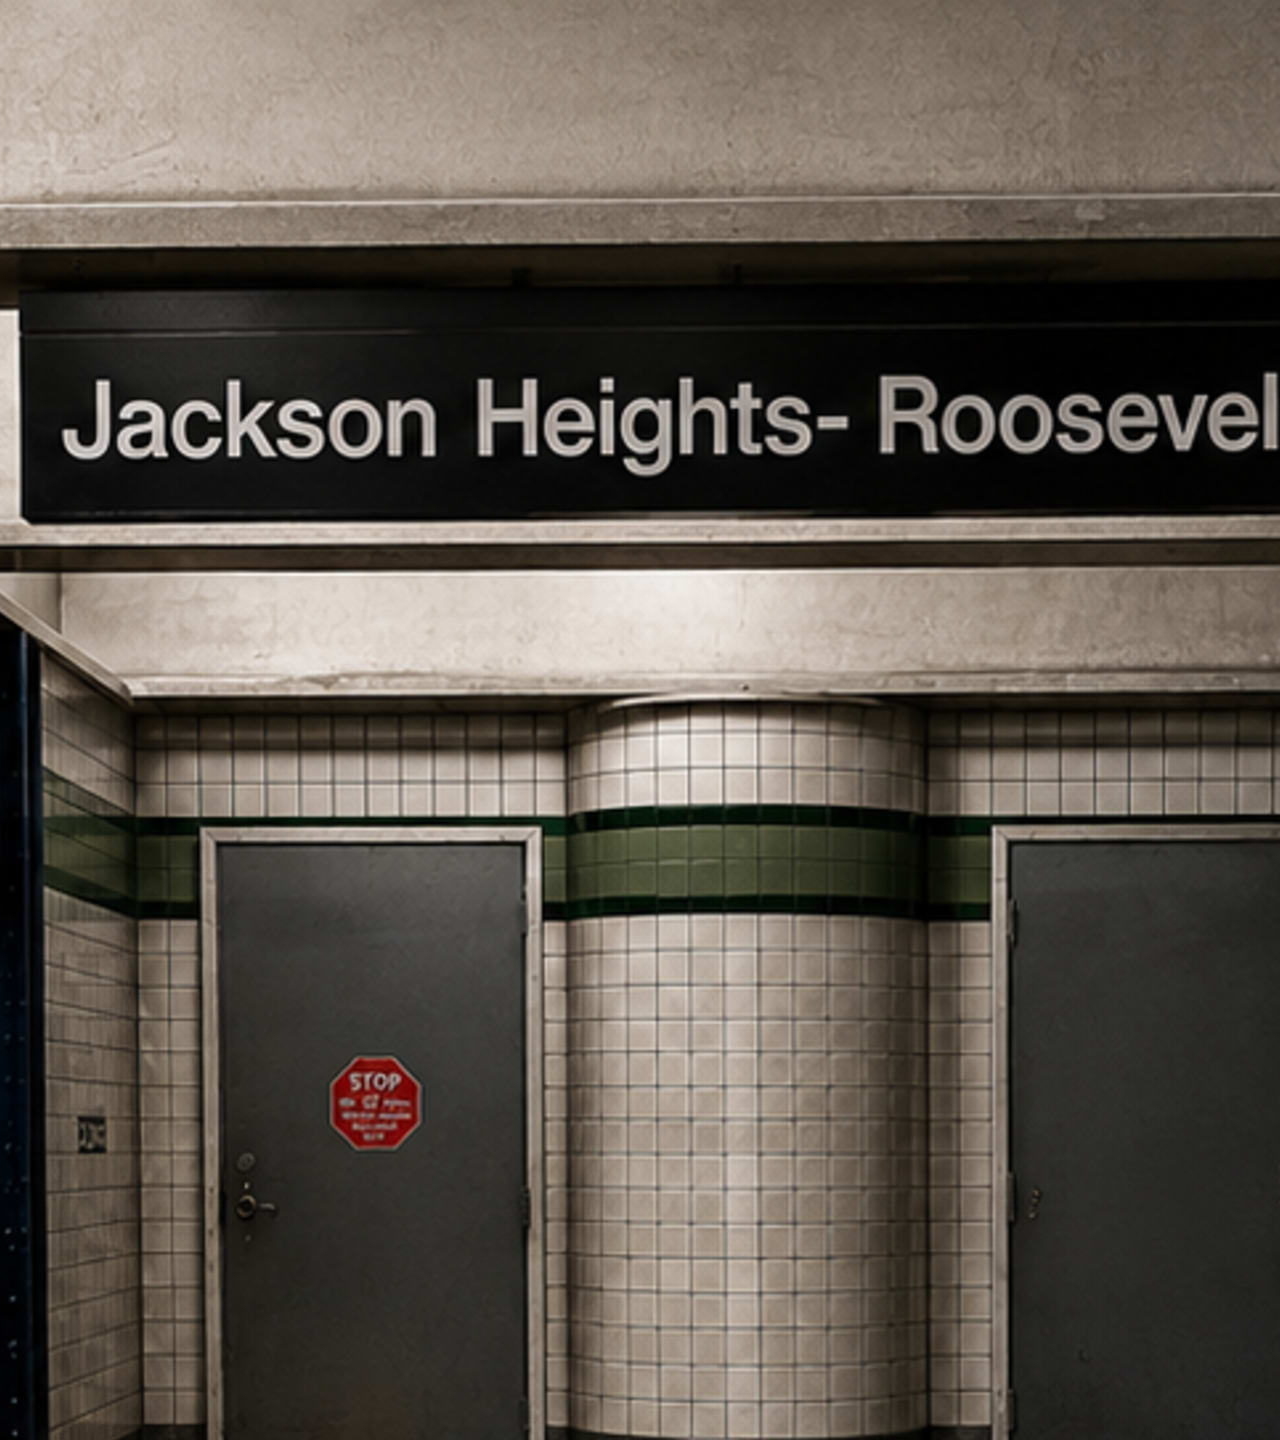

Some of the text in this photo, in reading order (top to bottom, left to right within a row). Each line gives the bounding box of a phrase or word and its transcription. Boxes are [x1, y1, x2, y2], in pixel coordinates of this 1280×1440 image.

[61, 378, 437, 460] Jackson
[477, 376, 849, 477] Heights-
[349, 1072, 401, 1091] STOP
